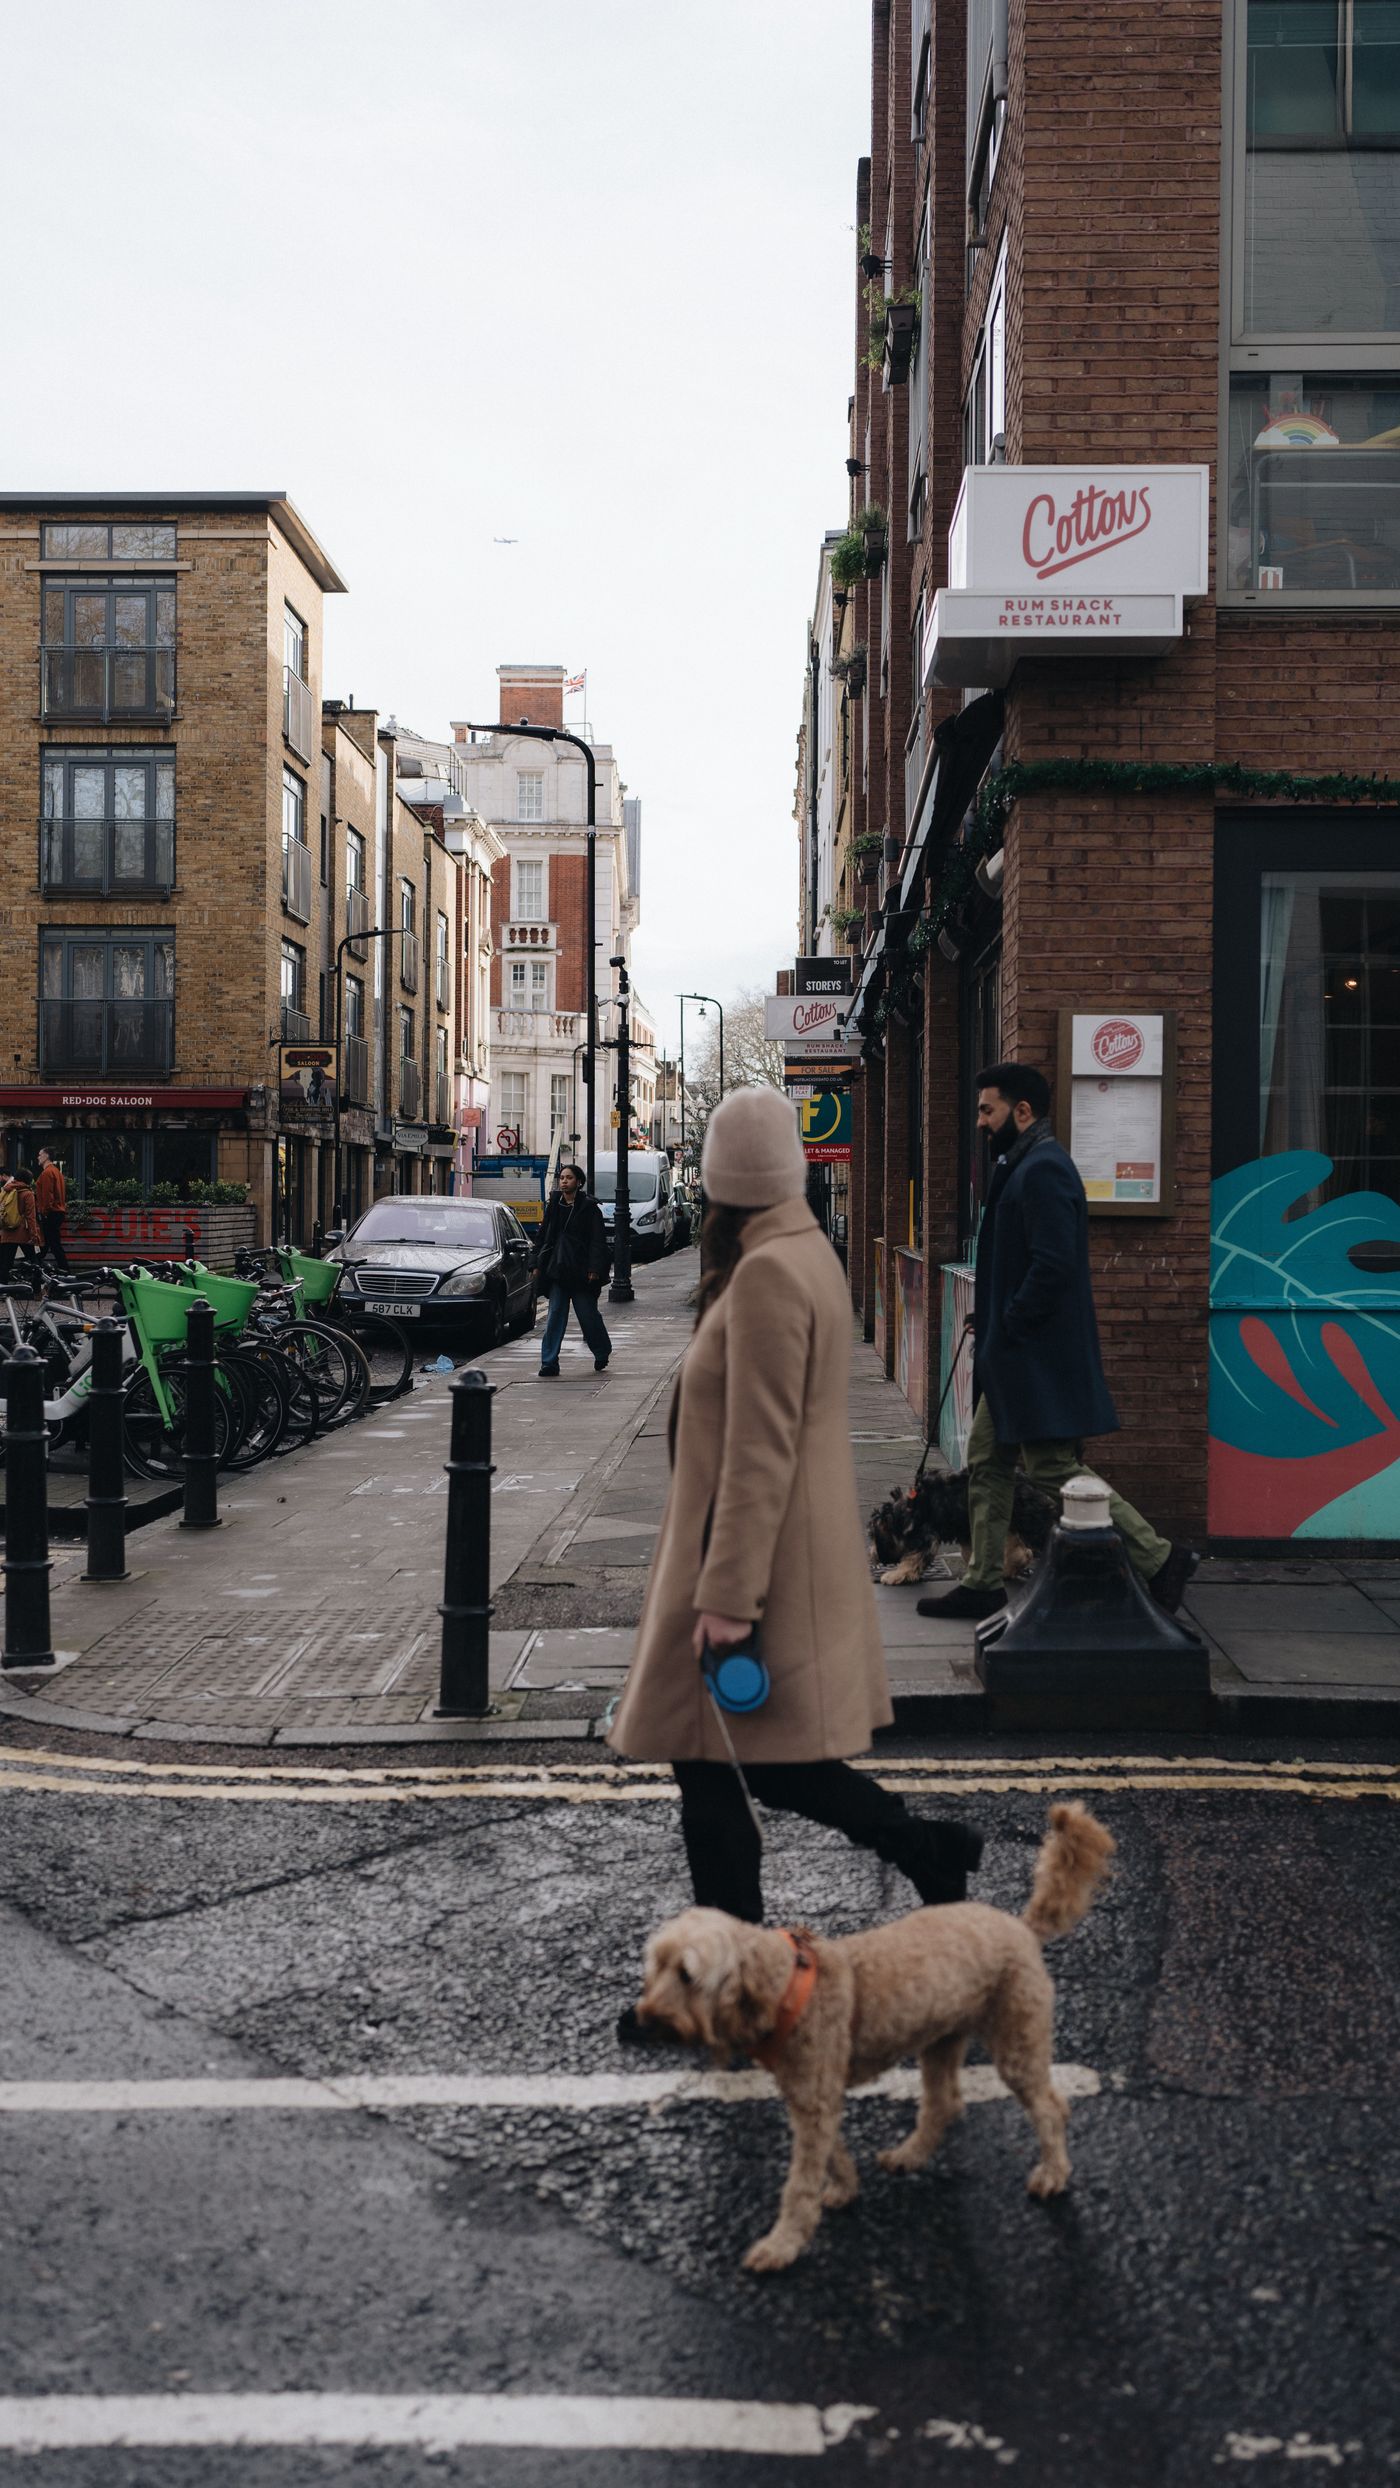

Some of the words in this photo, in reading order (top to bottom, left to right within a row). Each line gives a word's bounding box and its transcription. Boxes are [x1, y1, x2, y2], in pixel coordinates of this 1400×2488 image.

[1022, 484, 1151, 580] Cottons
[1005, 600, 1044, 611] RUM
[1051, 600, 1113, 611] SHACK
[998, 614, 1122, 626] RESTAURANT
[806, 980, 842, 991] STOREYS
[793, 1002, 837, 1035] Cottons
[1098, 1032, 1139, 1062] Cottons
[801, 1066, 816, 1074] FOR
[818, 1066, 835, 1074] SALE
[110, 1097, 153, 1106] SALOON
[372, 1303, 391, 1314] 587
[393, 1304, 413, 1315] CLK
